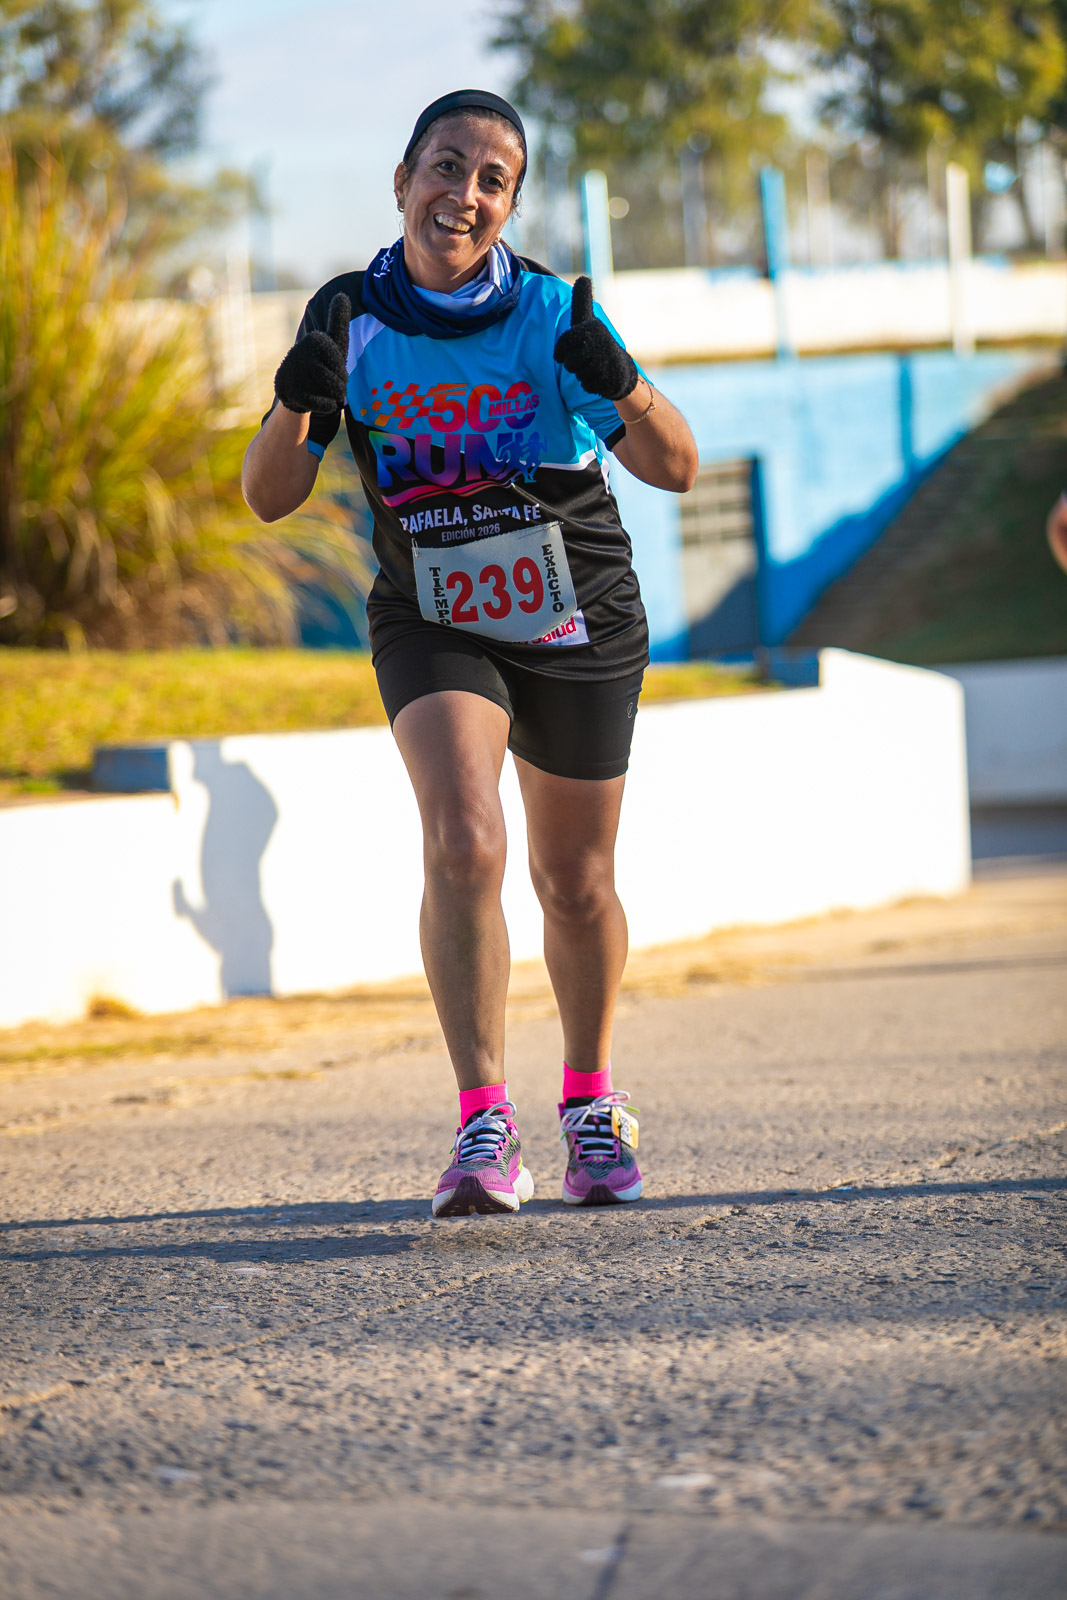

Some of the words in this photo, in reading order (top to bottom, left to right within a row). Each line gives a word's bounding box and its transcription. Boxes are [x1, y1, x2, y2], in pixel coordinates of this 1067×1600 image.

[428, 380, 536, 433] 500
[488, 394, 540, 417] MILLAS
[368, 430, 514, 488] RUN
[441, 527, 476, 542] EDICIÓN
[478, 522, 500, 538] 2026
[523, 502, 542, 521] FE
[446, 556, 544, 624] 239
[541, 543, 565, 613] EXACTO
